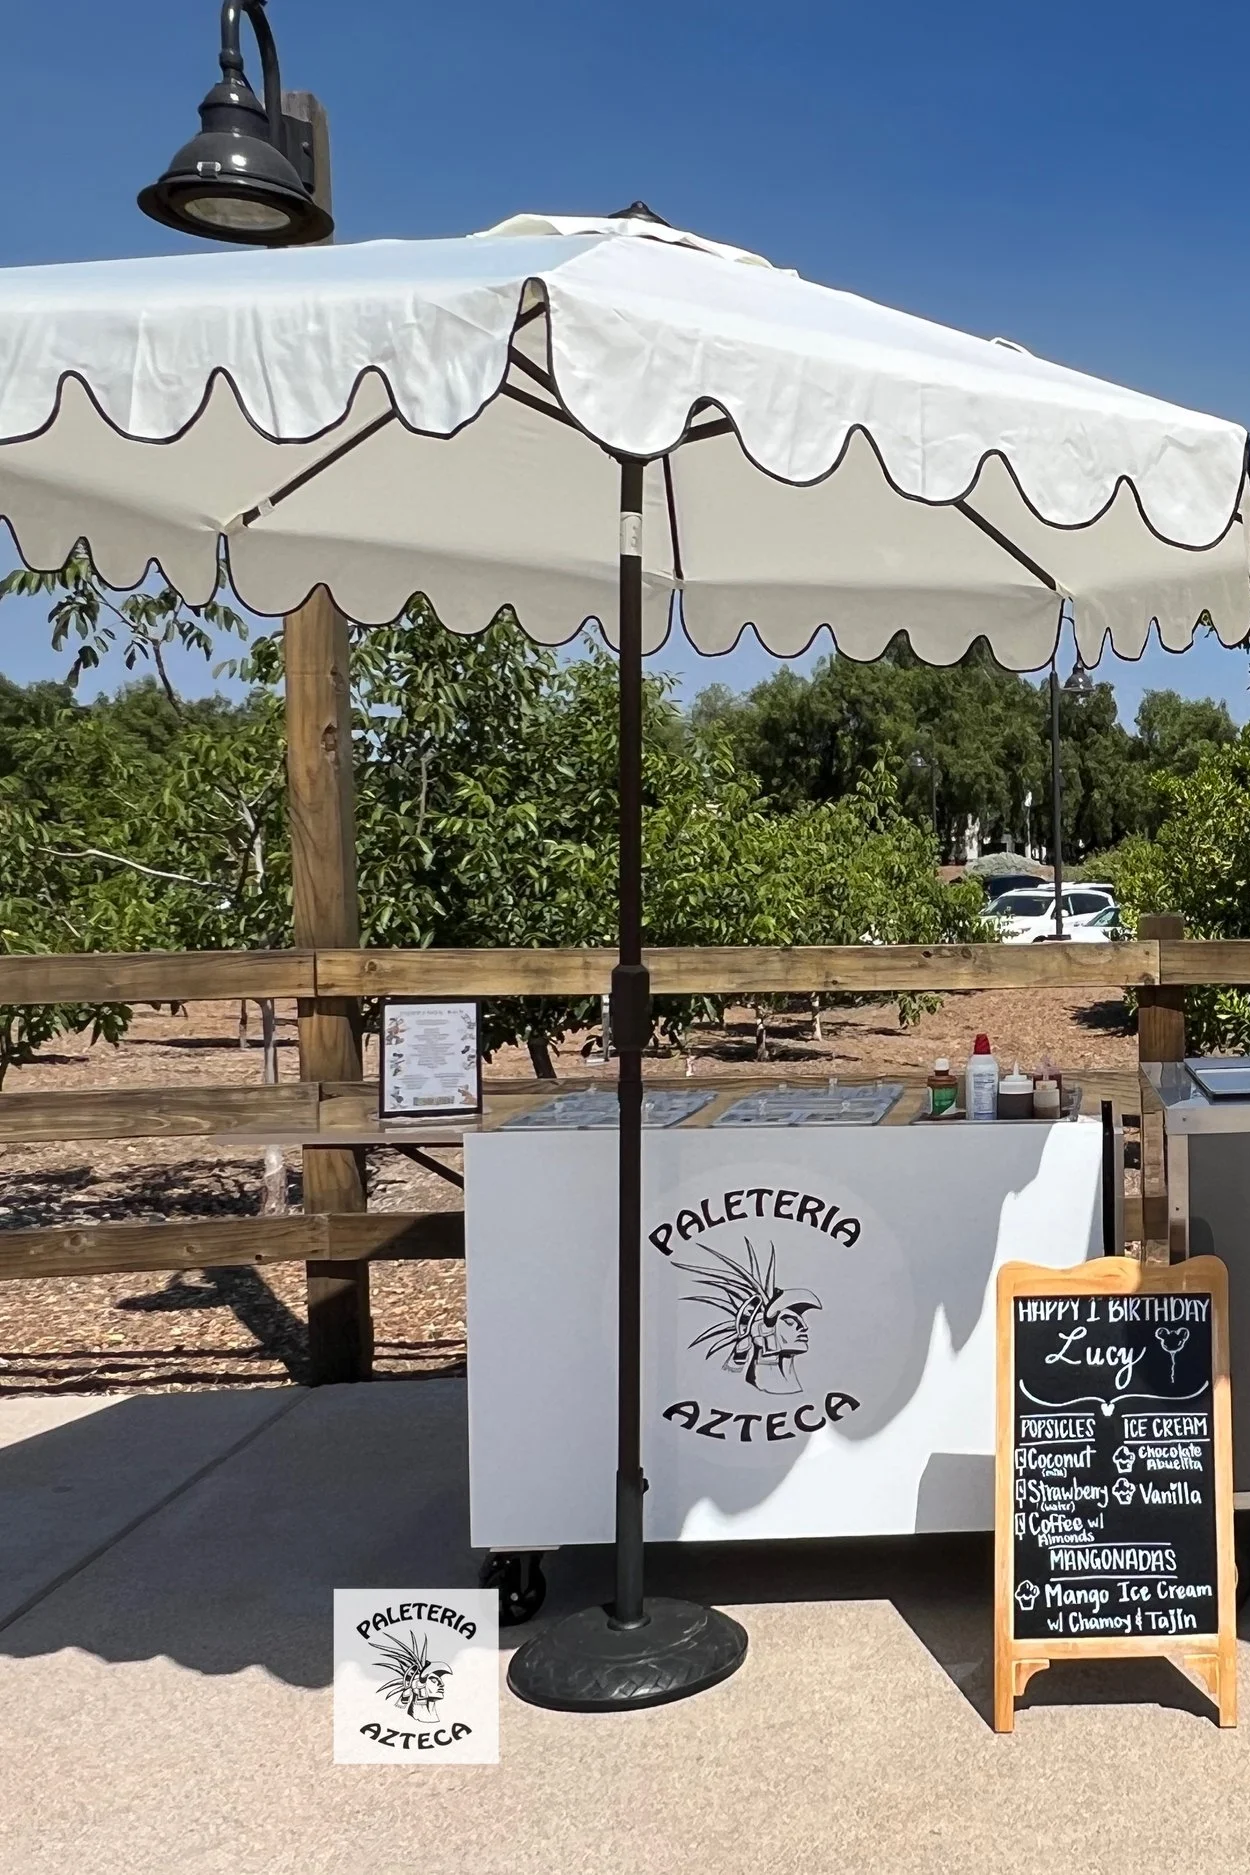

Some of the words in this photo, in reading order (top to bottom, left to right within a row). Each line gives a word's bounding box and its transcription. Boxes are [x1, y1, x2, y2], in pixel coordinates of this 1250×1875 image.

[648, 1188, 862, 1256] PALETERIA
[1018, 1298, 1080, 1322] HAPPY
[1108, 1297, 1210, 1323] BIRTHDAY
[1045, 1326, 1147, 1390] Lucy
[662, 1392, 861, 1442] AZTECA
[1021, 1418, 1096, 1438] POPSICLES
[1124, 1418, 1148, 1438] ICE
[1152, 1417, 1208, 1438] CREAM
[1027, 1445, 1097, 1470] Coconut
[1138, 1443, 1202, 1459] Chocolate
[1027, 1476, 1109, 1508] Strawberry
[1139, 1481, 1202, 1505] Vanilla
[1028, 1512, 1083, 1536] Coffee
[1037, 1528, 1095, 1547] Almonds
[1049, 1549, 1177, 1571] MANGONADAS
[1045, 1583, 1109, 1613] Mango
[1117, 1581, 1151, 1603] Ice
[1156, 1580, 1213, 1599] Cream
[1068, 1611, 1132, 1634] Chamoy
